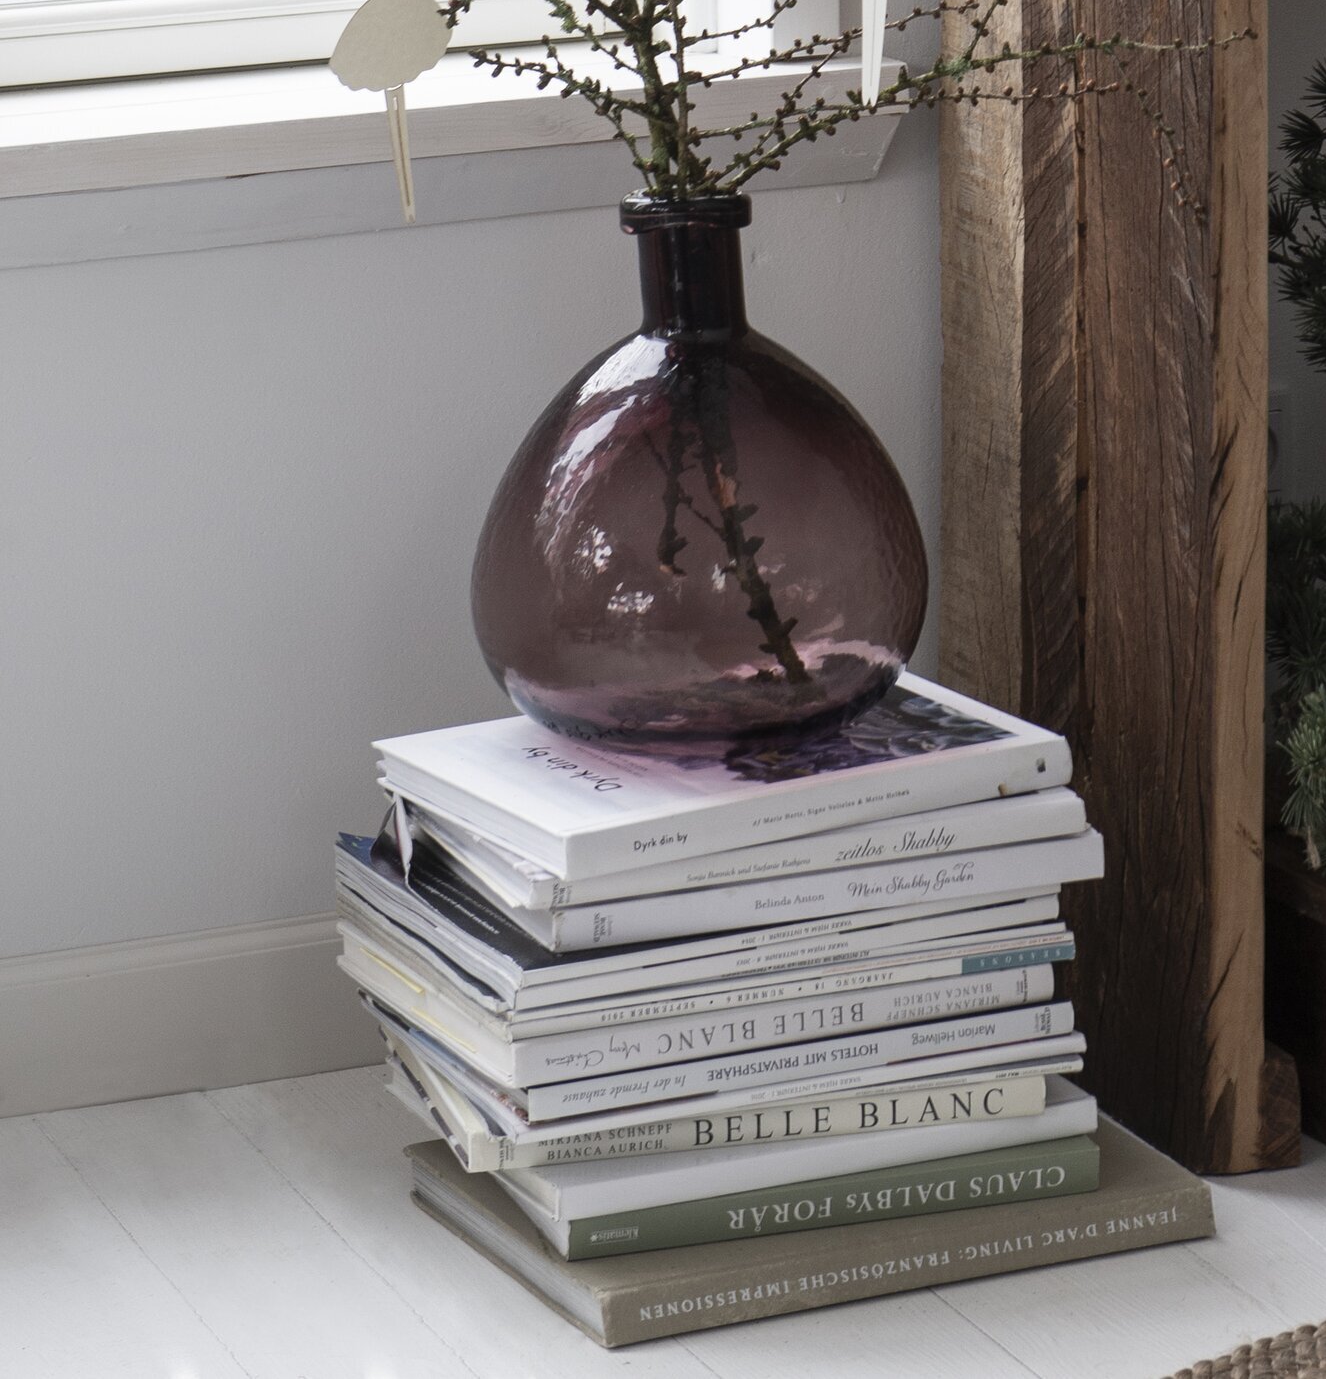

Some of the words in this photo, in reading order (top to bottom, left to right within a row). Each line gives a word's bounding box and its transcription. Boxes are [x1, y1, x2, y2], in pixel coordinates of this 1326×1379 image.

[521, 746, 553, 759] by
[569, 769, 623, 793] Dyrk
[633, 836, 658, 853] Dyrk
[660, 833, 675, 847] din
[677, 831, 689, 847] by
[835, 838, 885, 862] zeitlos
[892, 827, 958, 854] Shabby
[754, 893, 791, 911] Belinda
[793, 891, 826, 906] Anton
[847, 880, 884, 897] Mein
[886, 874, 931, 896] Shabby
[932, 862, 975, 889] Garden
[892, 990, 941, 1007] AURICH
[772, 1001, 866, 1037] BELLE
[655, 1018, 756, 1055] BLANC
[911, 1029, 956, 1048] Hellweg
[959, 1024, 996, 1040] Marion
[802, 1050, 827, 1068] MIT
[830, 1043, 880, 1064] HOTELS
[673, 1075, 687, 1089] In
[706, 1055, 800, 1085] PRIVATSPHÄRE
[563, 1087, 608, 1104] zuhause
[610, 1080, 649, 1099] Fremde
[653, 1077, 672, 1091] der
[693, 1105, 834, 1148] BELLE
[859, 1086, 1007, 1132] BLANC
[608, 1122, 673, 1141] SCHNEPF
[547, 1144, 602, 1161] BIANCA
[608, 1139, 664, 1155] AURICH
[968, 1164, 1067, 1200] CLAUS
[844, 1177, 957, 1213] DALBYs
[726, 1196, 832, 1233] FORÅR
[1106, 1206, 1179, 1236] JEANNE
[1040, 1221, 1098, 1246] D'ARC
[956, 1234, 1034, 1259] LIVING:
[796, 1250, 951, 1292] FRANZÖSISCHE
[637, 1281, 790, 1322] IMPRESSIONEN
